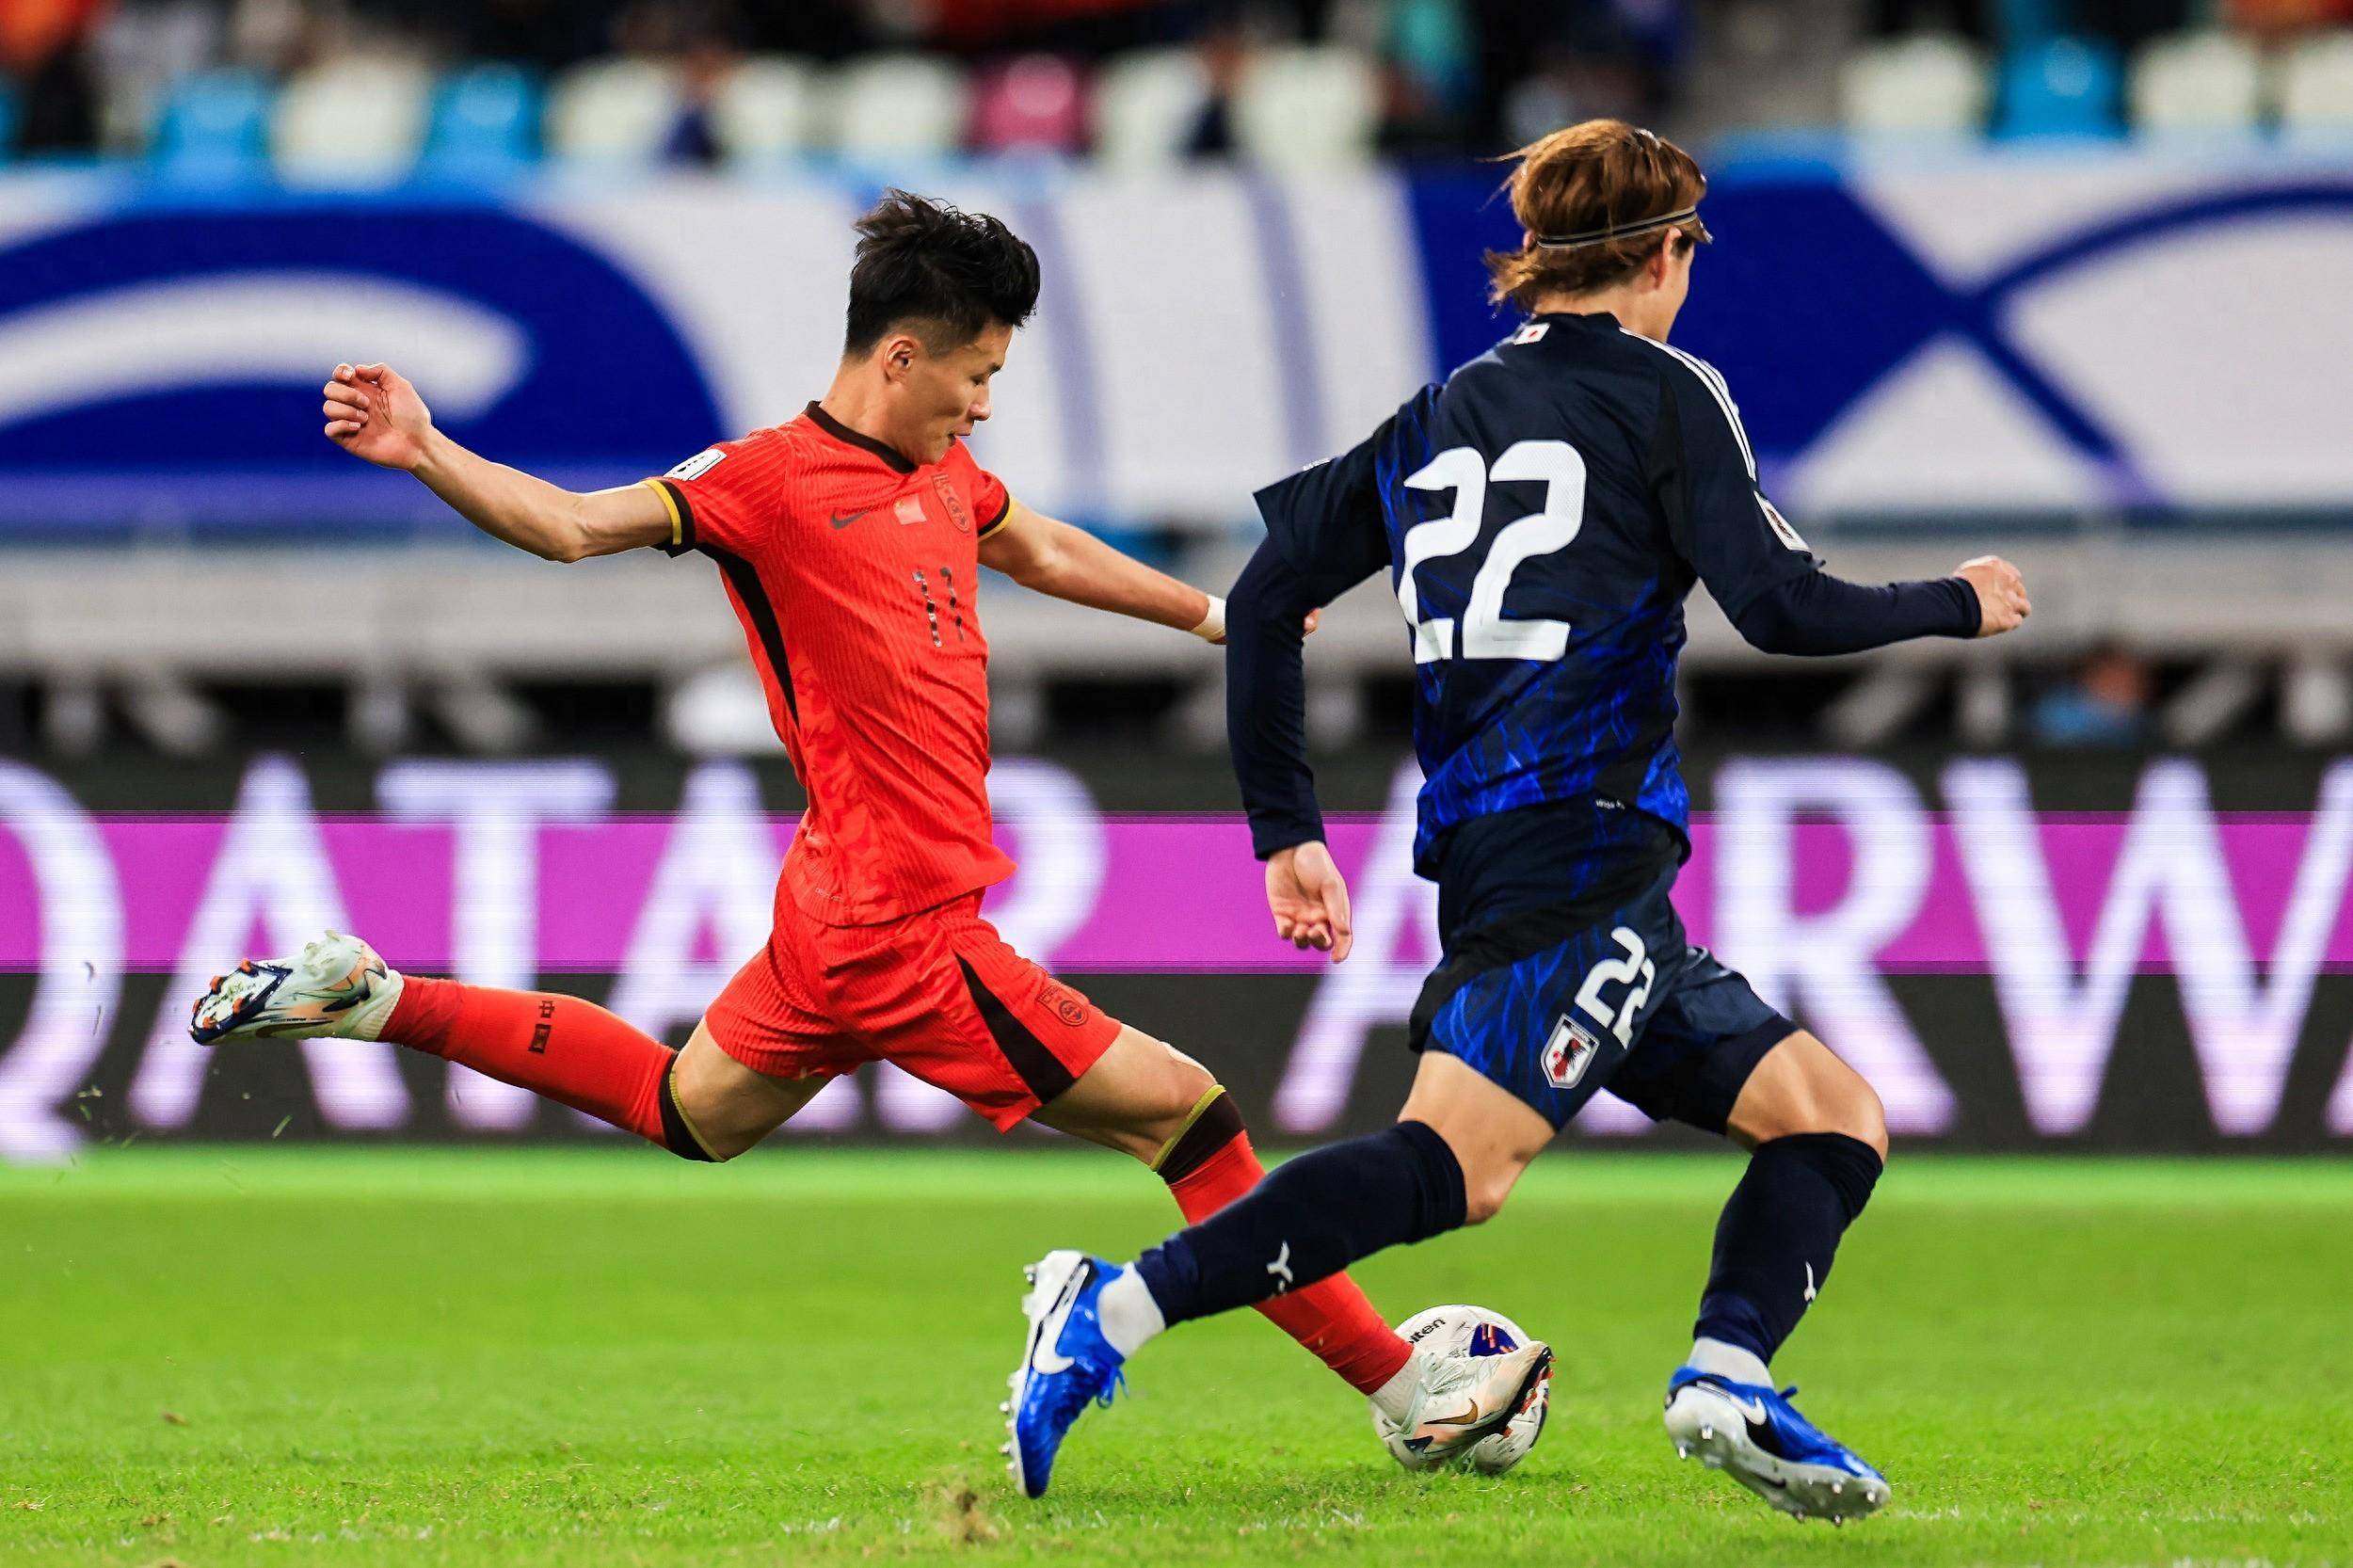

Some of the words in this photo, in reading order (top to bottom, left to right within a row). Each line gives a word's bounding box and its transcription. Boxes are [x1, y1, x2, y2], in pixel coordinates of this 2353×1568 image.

[911, 568, 964, 648] 11
[1398, 440, 1587, 664] 22
[1271, 755, 2353, 1135] ARW
[1574, 926, 1656, 1049] 22
[1408, 1318, 1447, 1344] lten
